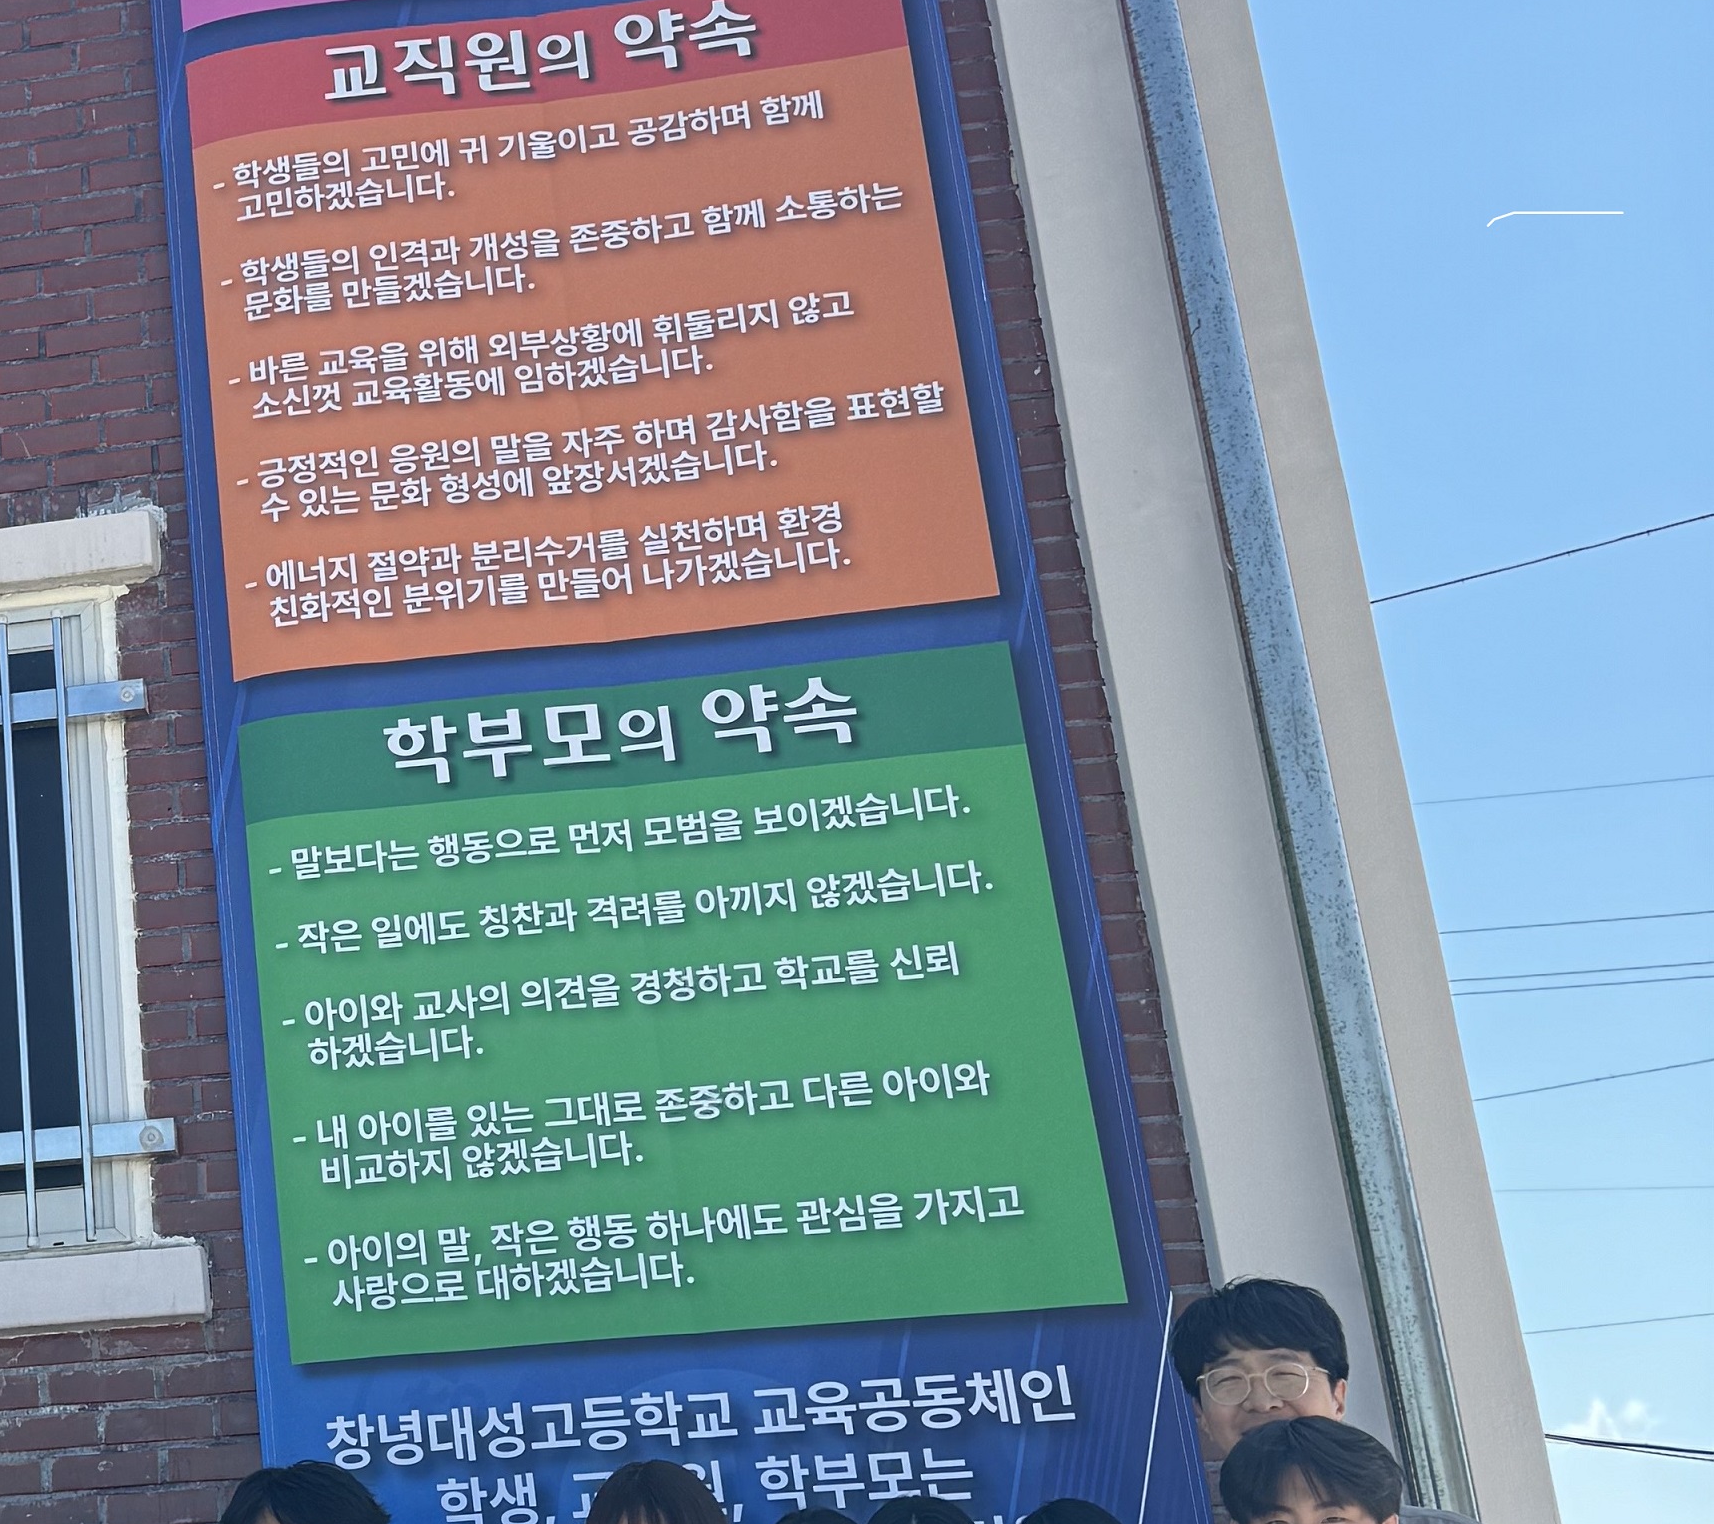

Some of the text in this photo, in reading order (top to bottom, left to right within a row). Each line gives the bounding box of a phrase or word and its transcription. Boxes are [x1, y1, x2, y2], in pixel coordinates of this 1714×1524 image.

[324, 29, 590, 100] 교직원의
[231, 89, 824, 189] 학생들의 고민에 귀 기울이고 공감하며 함께
[236, 170, 455, 222] 고민하겠습니다.
[239, 182, 903, 287] 학생들의 인격과 개성을 존중하고 함께 소통하는
[243, 263, 536, 322] 문화를 만들겠습니다.
[248, 291, 855, 386] 바른 교육을 위해 외부상황에 휘둘리지 않고
[252, 344, 714, 419] 소신껏 교육활동에 임하겠습니다.
[256, 380, 945, 489] 긍정적인 응원의 말을 자주 하며 감사함을 표현할
[260, 439, 778, 523] 수 있는 문화 형성에 앞장서겠습니다.
[265, 500, 843, 591] 에너지 절약과 분리수거를 실천하며 환경
[269, 537, 851, 628] 친화적인 분위기를 만들어 나가겠습니다.
[382, 676, 858, 784] 학부모의 약속
[290, 784, 971, 881] 말보다는 행동으로 먼저 모범을 보이겠습니다.
[297, 859, 994, 955] 작은 일에도 칭찬과 격려를 아끼지 않겠습니다.
[304, 940, 960, 1032] 아이와 교사의 의견을 경청하고 학교를 신뢰
[307, 1024, 484, 1071] 하겠습니다.
[316, 1059, 991, 1150] 내 아이를 있는 그대로 존중하고 다른 아이와
[320, 1130, 644, 1190] 비교하지 않겠습니다.
[327, 1185, 1025, 1271] 아이의 말, 작은 행동 하나에도 관심을 가지고
[332, 1250, 695, 1313] 사랑으로 대하겠습니다.
[325, 1364, 1076, 1470] 창녕대성고등학교 교육공동체인
[754, 1447, 974, 1511] 학부모는
